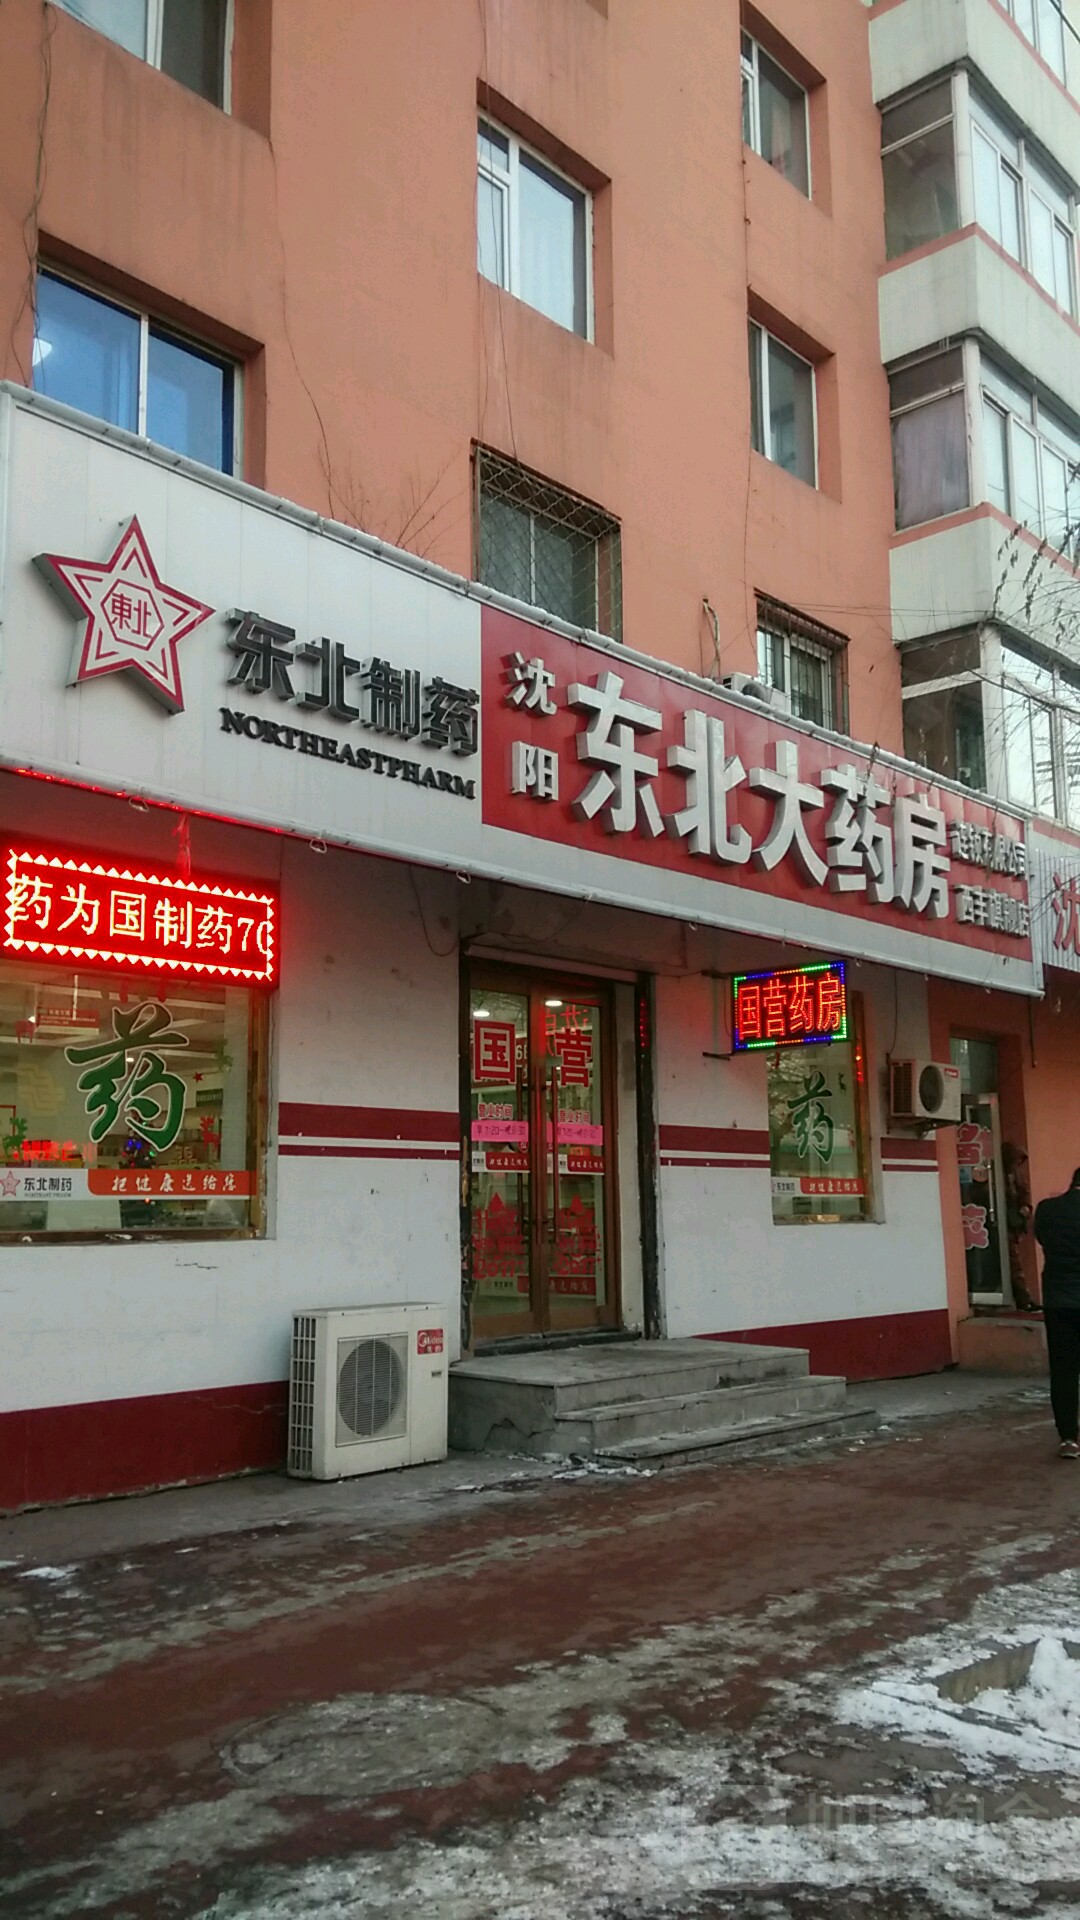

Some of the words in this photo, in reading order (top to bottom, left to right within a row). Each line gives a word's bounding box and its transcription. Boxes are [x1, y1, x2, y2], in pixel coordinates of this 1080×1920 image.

[111, 592, 153, 639] 東北
[226, 607, 480, 756] 东北制药
[567, 671, 950, 918] 东北大药房
[738, 973, 842, 1041] 国营药房
[64, 1000, 190, 1152] 药
[474, 1020, 516, 1084] 国
[555, 1027, 592, 1087] 营
[478, 1103, 513, 1119] 营业时间
[787, 1071, 834, 1164] 药
[24, 1177, 72, 1192] 东北制药
